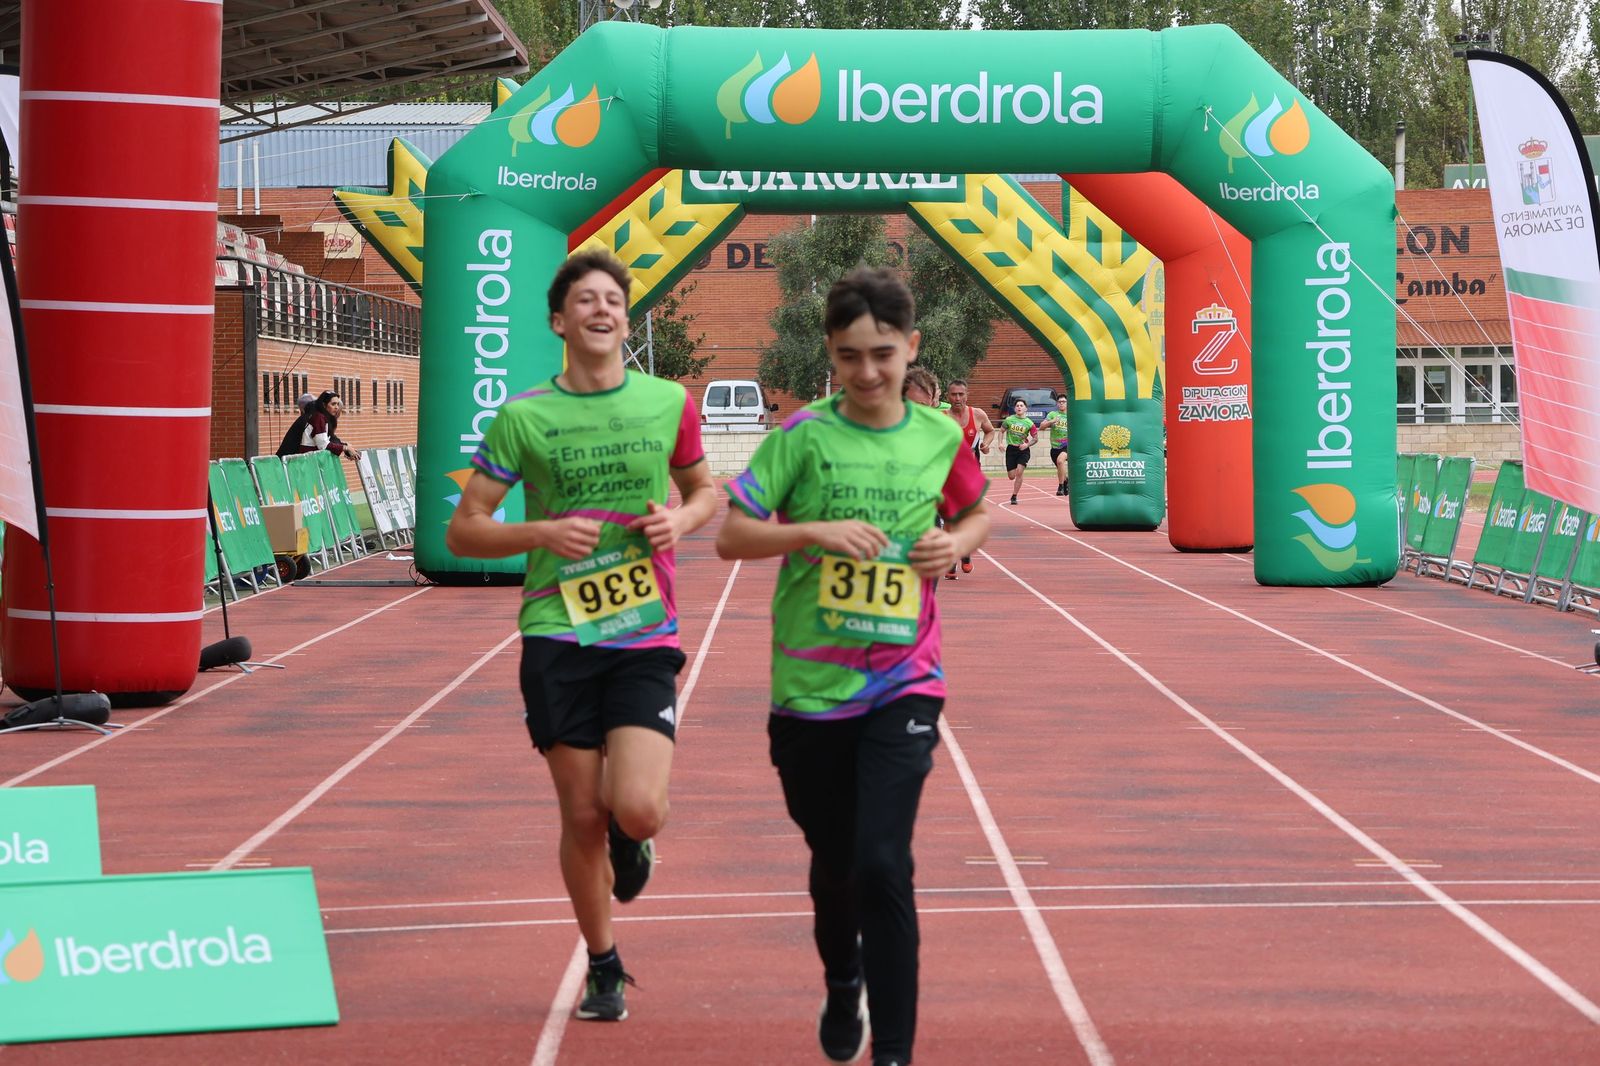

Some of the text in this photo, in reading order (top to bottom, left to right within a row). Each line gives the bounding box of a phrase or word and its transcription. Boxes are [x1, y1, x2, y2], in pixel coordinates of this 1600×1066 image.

[838, 69, 1103, 124] Iberdrola
[497, 166, 597, 190] Iberdrola
[1219, 180, 1319, 201] Iberdrola
[1396, 226, 1470, 255] ON
[1305, 242, 1352, 469] Iberdrola
[1179, 403, 1252, 420] ZAMORA
[561, 437, 663, 462] En marcha
[563, 461, 628, 481] contra
[1086, 461, 1145, 470] FUNDACION
[1086, 469, 1145, 478] CAJA RURAL
[831, 483, 858, 499] En
[831, 506, 899, 522] contra
[578, 565, 652, 614] 336
[831, 562, 904, 606] 315
[54, 925, 272, 977] Iberdrola
